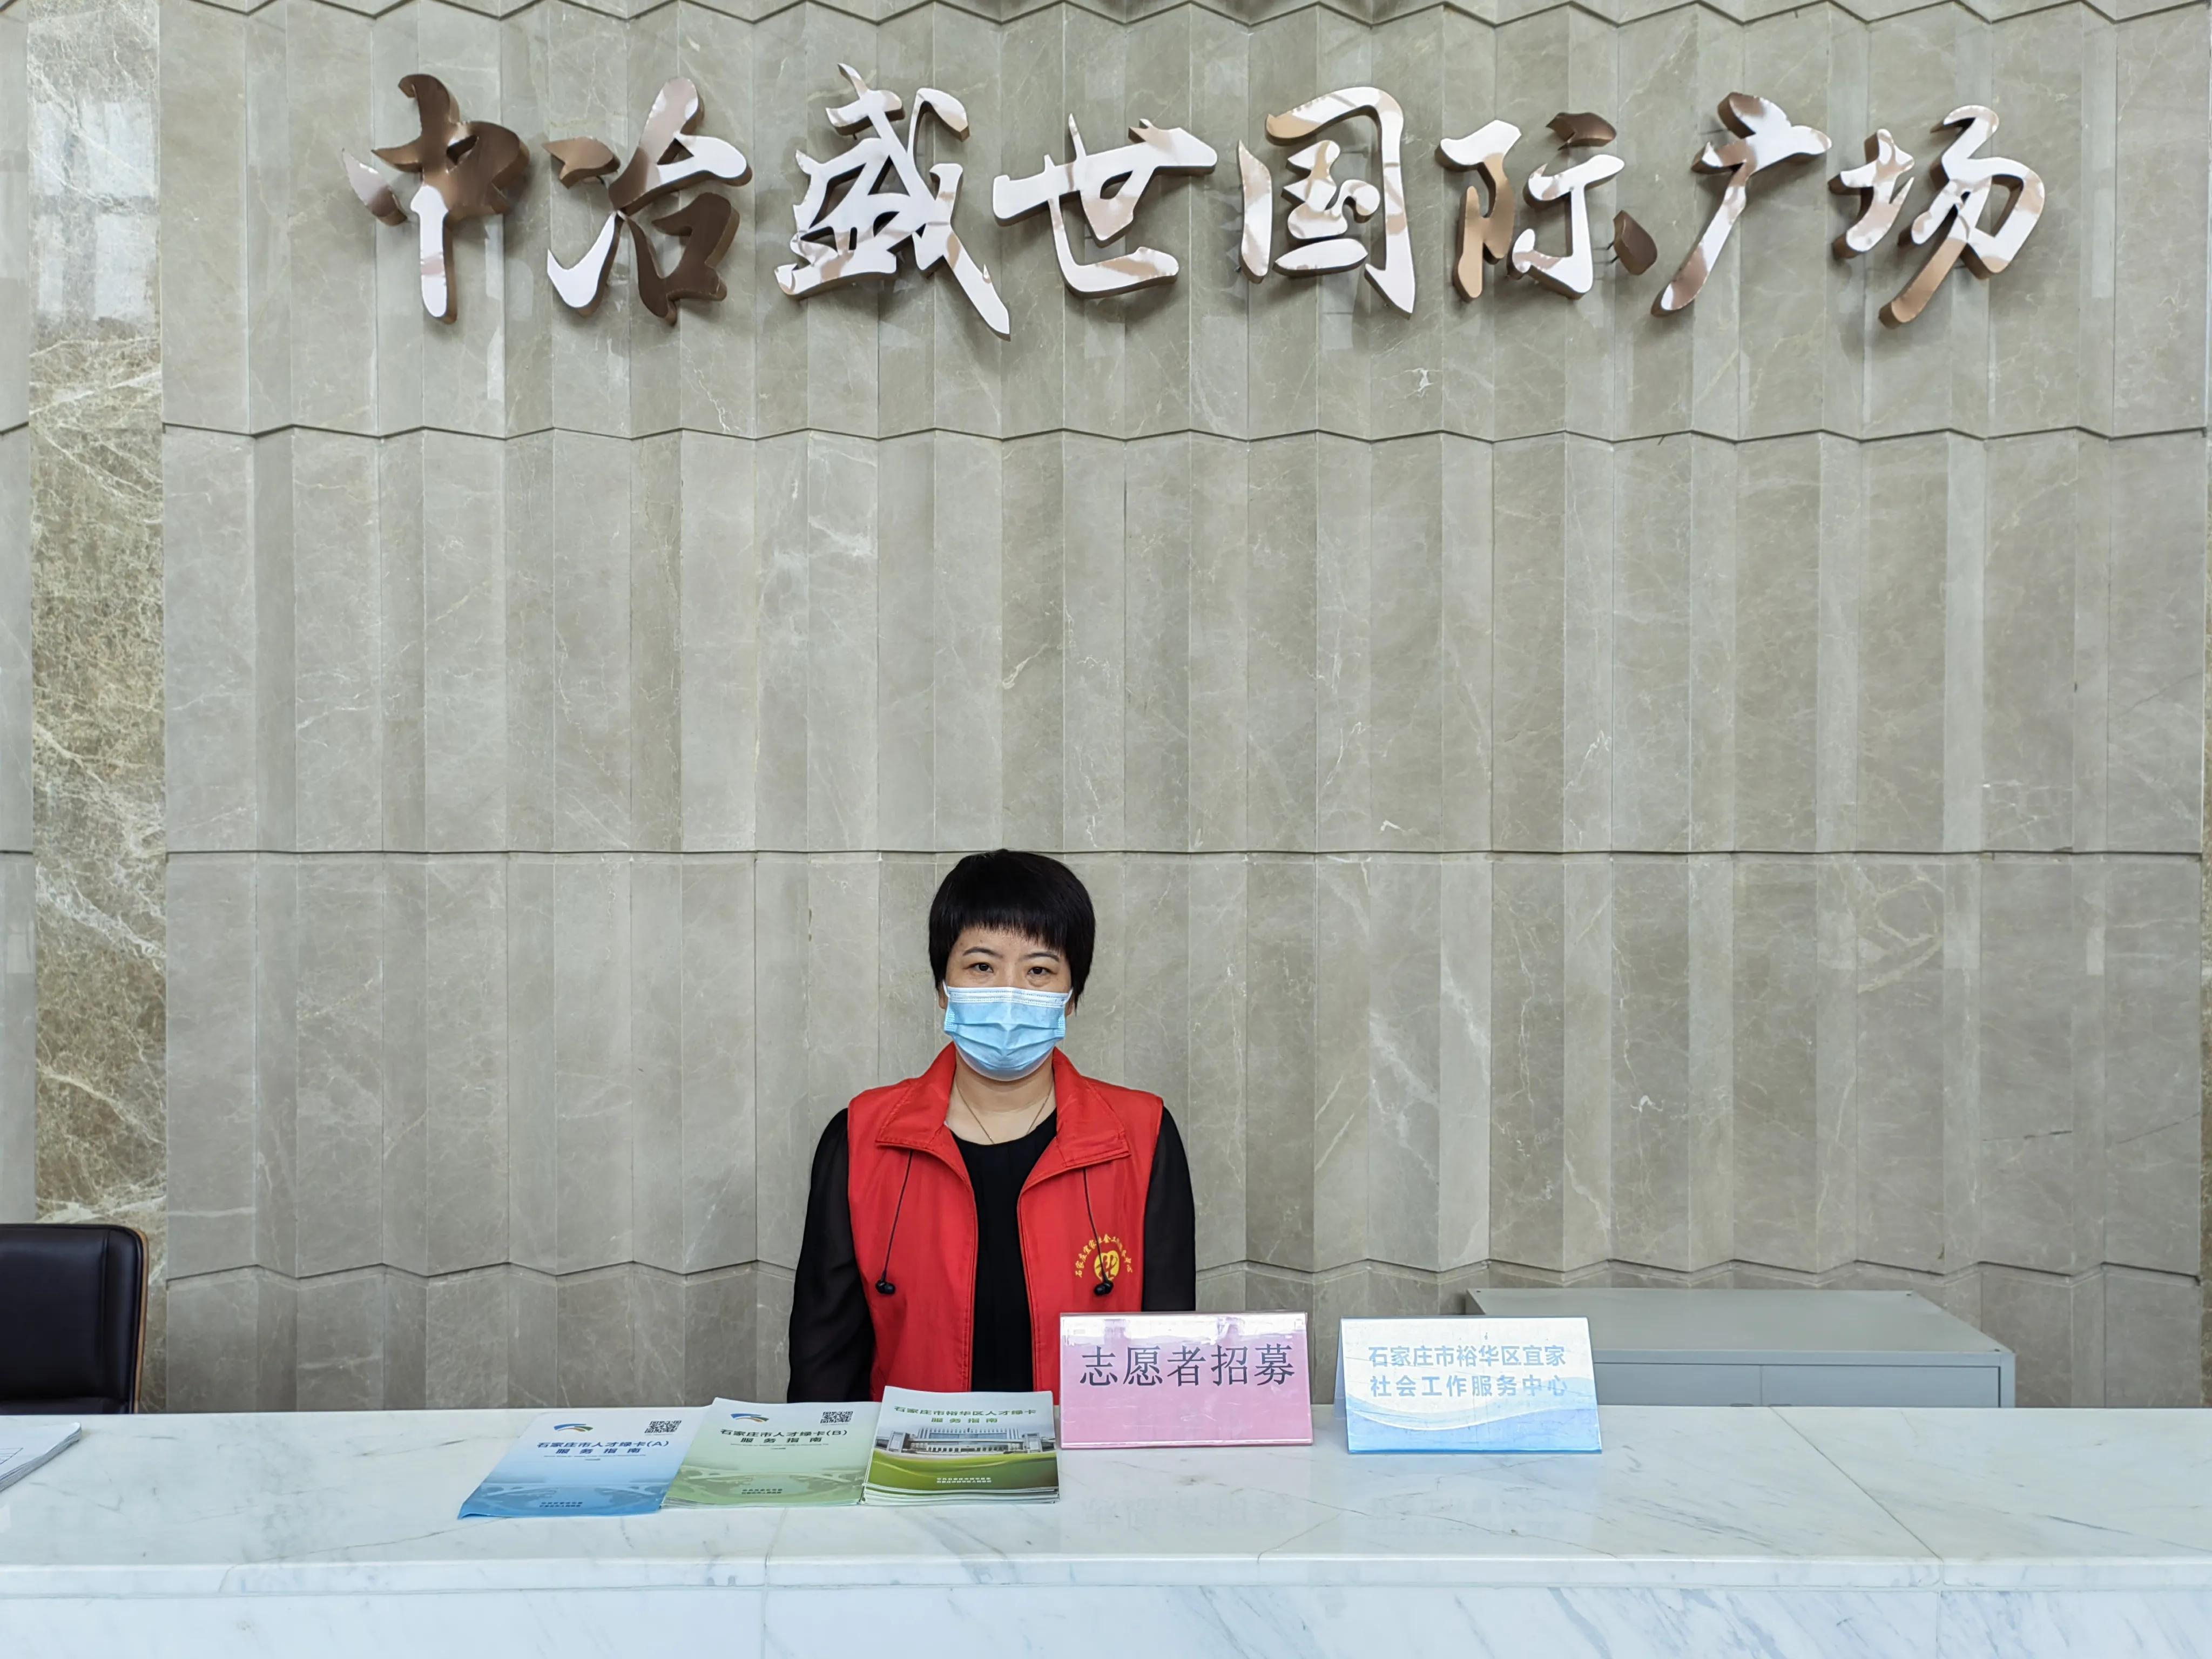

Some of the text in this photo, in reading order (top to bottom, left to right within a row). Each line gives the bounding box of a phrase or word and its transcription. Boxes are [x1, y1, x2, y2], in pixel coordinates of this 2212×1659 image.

[1080, 1343, 1296, 1387] 志愿者招募
[1368, 1345, 1567, 1367] 石家庄市裕华区宜家
[1370, 1374, 1568, 1398] 社会工作服务中心
